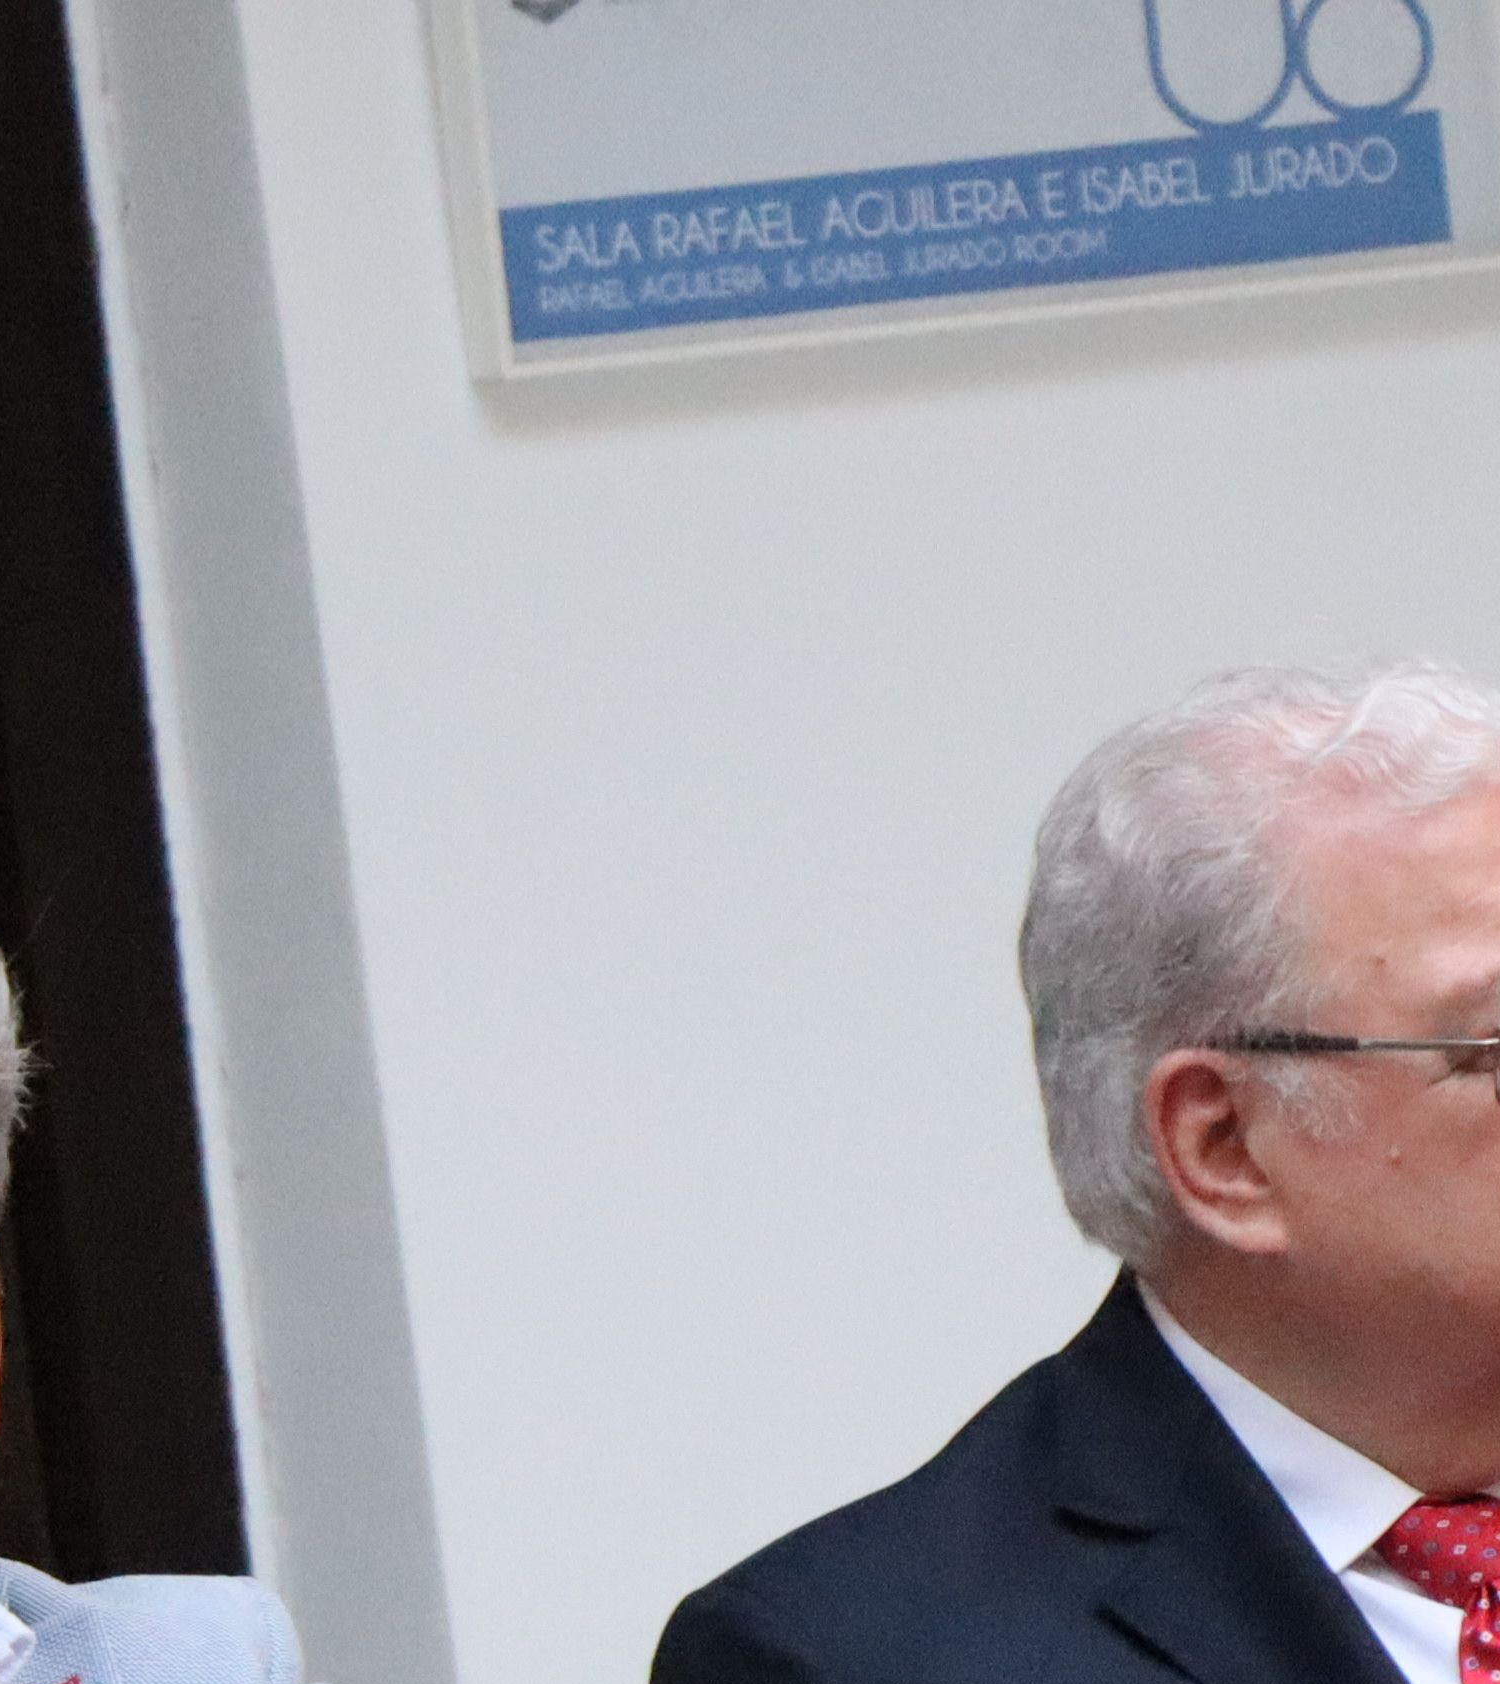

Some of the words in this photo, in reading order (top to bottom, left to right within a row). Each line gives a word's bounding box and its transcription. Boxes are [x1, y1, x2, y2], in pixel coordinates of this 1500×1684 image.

[537, 222, 641, 272] SALA
[654, 201, 804, 259] RAFAEL
[822, 176, 1029, 240] AGUILERA
[1040, 171, 1067, 219] E
[1079, 158, 1211, 214] ISABEL
[1229, 135, 1398, 200] JURADO
[539, 278, 633, 314] RAFAEL
[811, 251, 893, 286] ISABEL
[904, 236, 1007, 276] JURADO
[1013, 228, 1107, 263] ROOM
